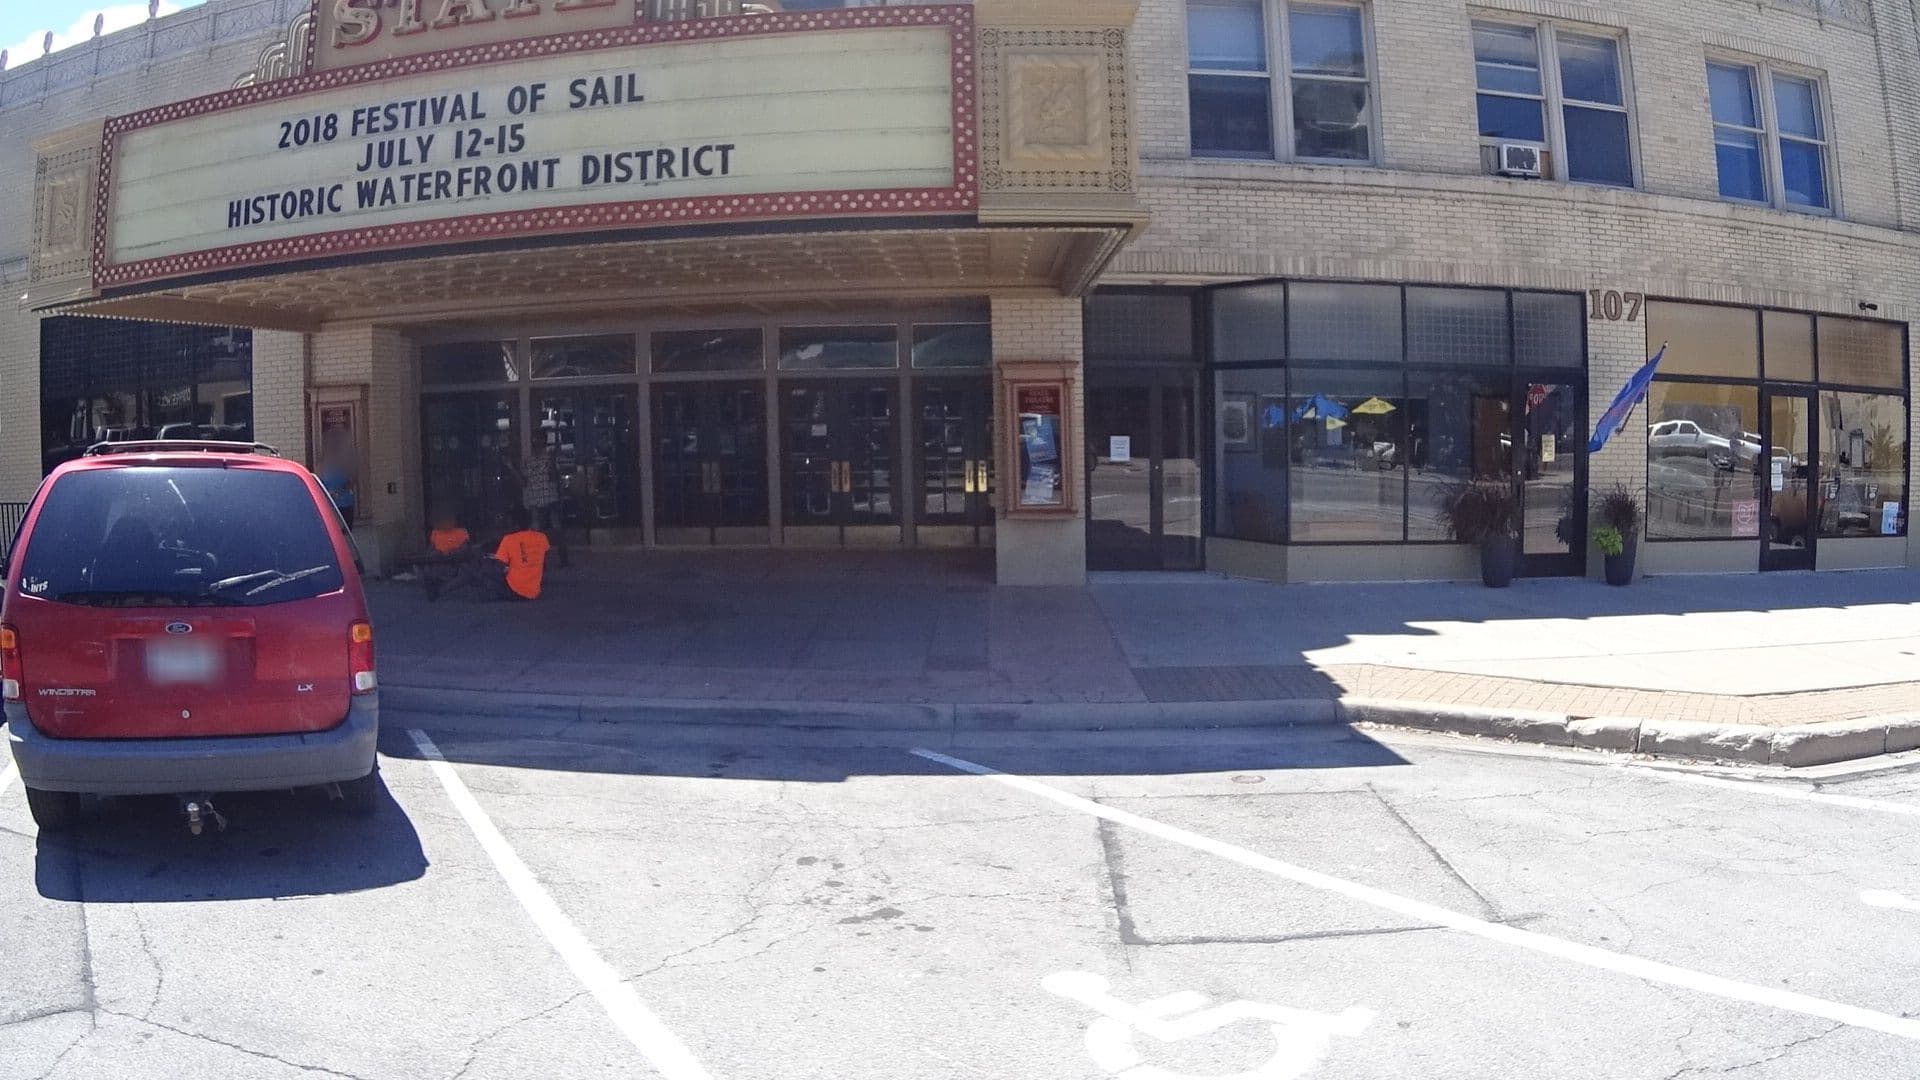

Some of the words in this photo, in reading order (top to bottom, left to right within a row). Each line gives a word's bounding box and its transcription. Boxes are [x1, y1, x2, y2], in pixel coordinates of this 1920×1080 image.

[278, 113, 338, 149] 2018
[351, 87, 486, 137] FESTIVAL
[507, 82, 546, 115] OF
[569, 73, 644, 109] SAIL
[356, 133, 434, 172] JULY
[454, 122, 526, 160] 12-15
[227, 183, 343, 229] HISTORIC
[356, 158, 560, 210] WATERFRONT
[582, 143, 735, 185] DISTRICT
[1589, 289, 1643, 321] 107
[38, 688, 97, 697] WINDSTAR
